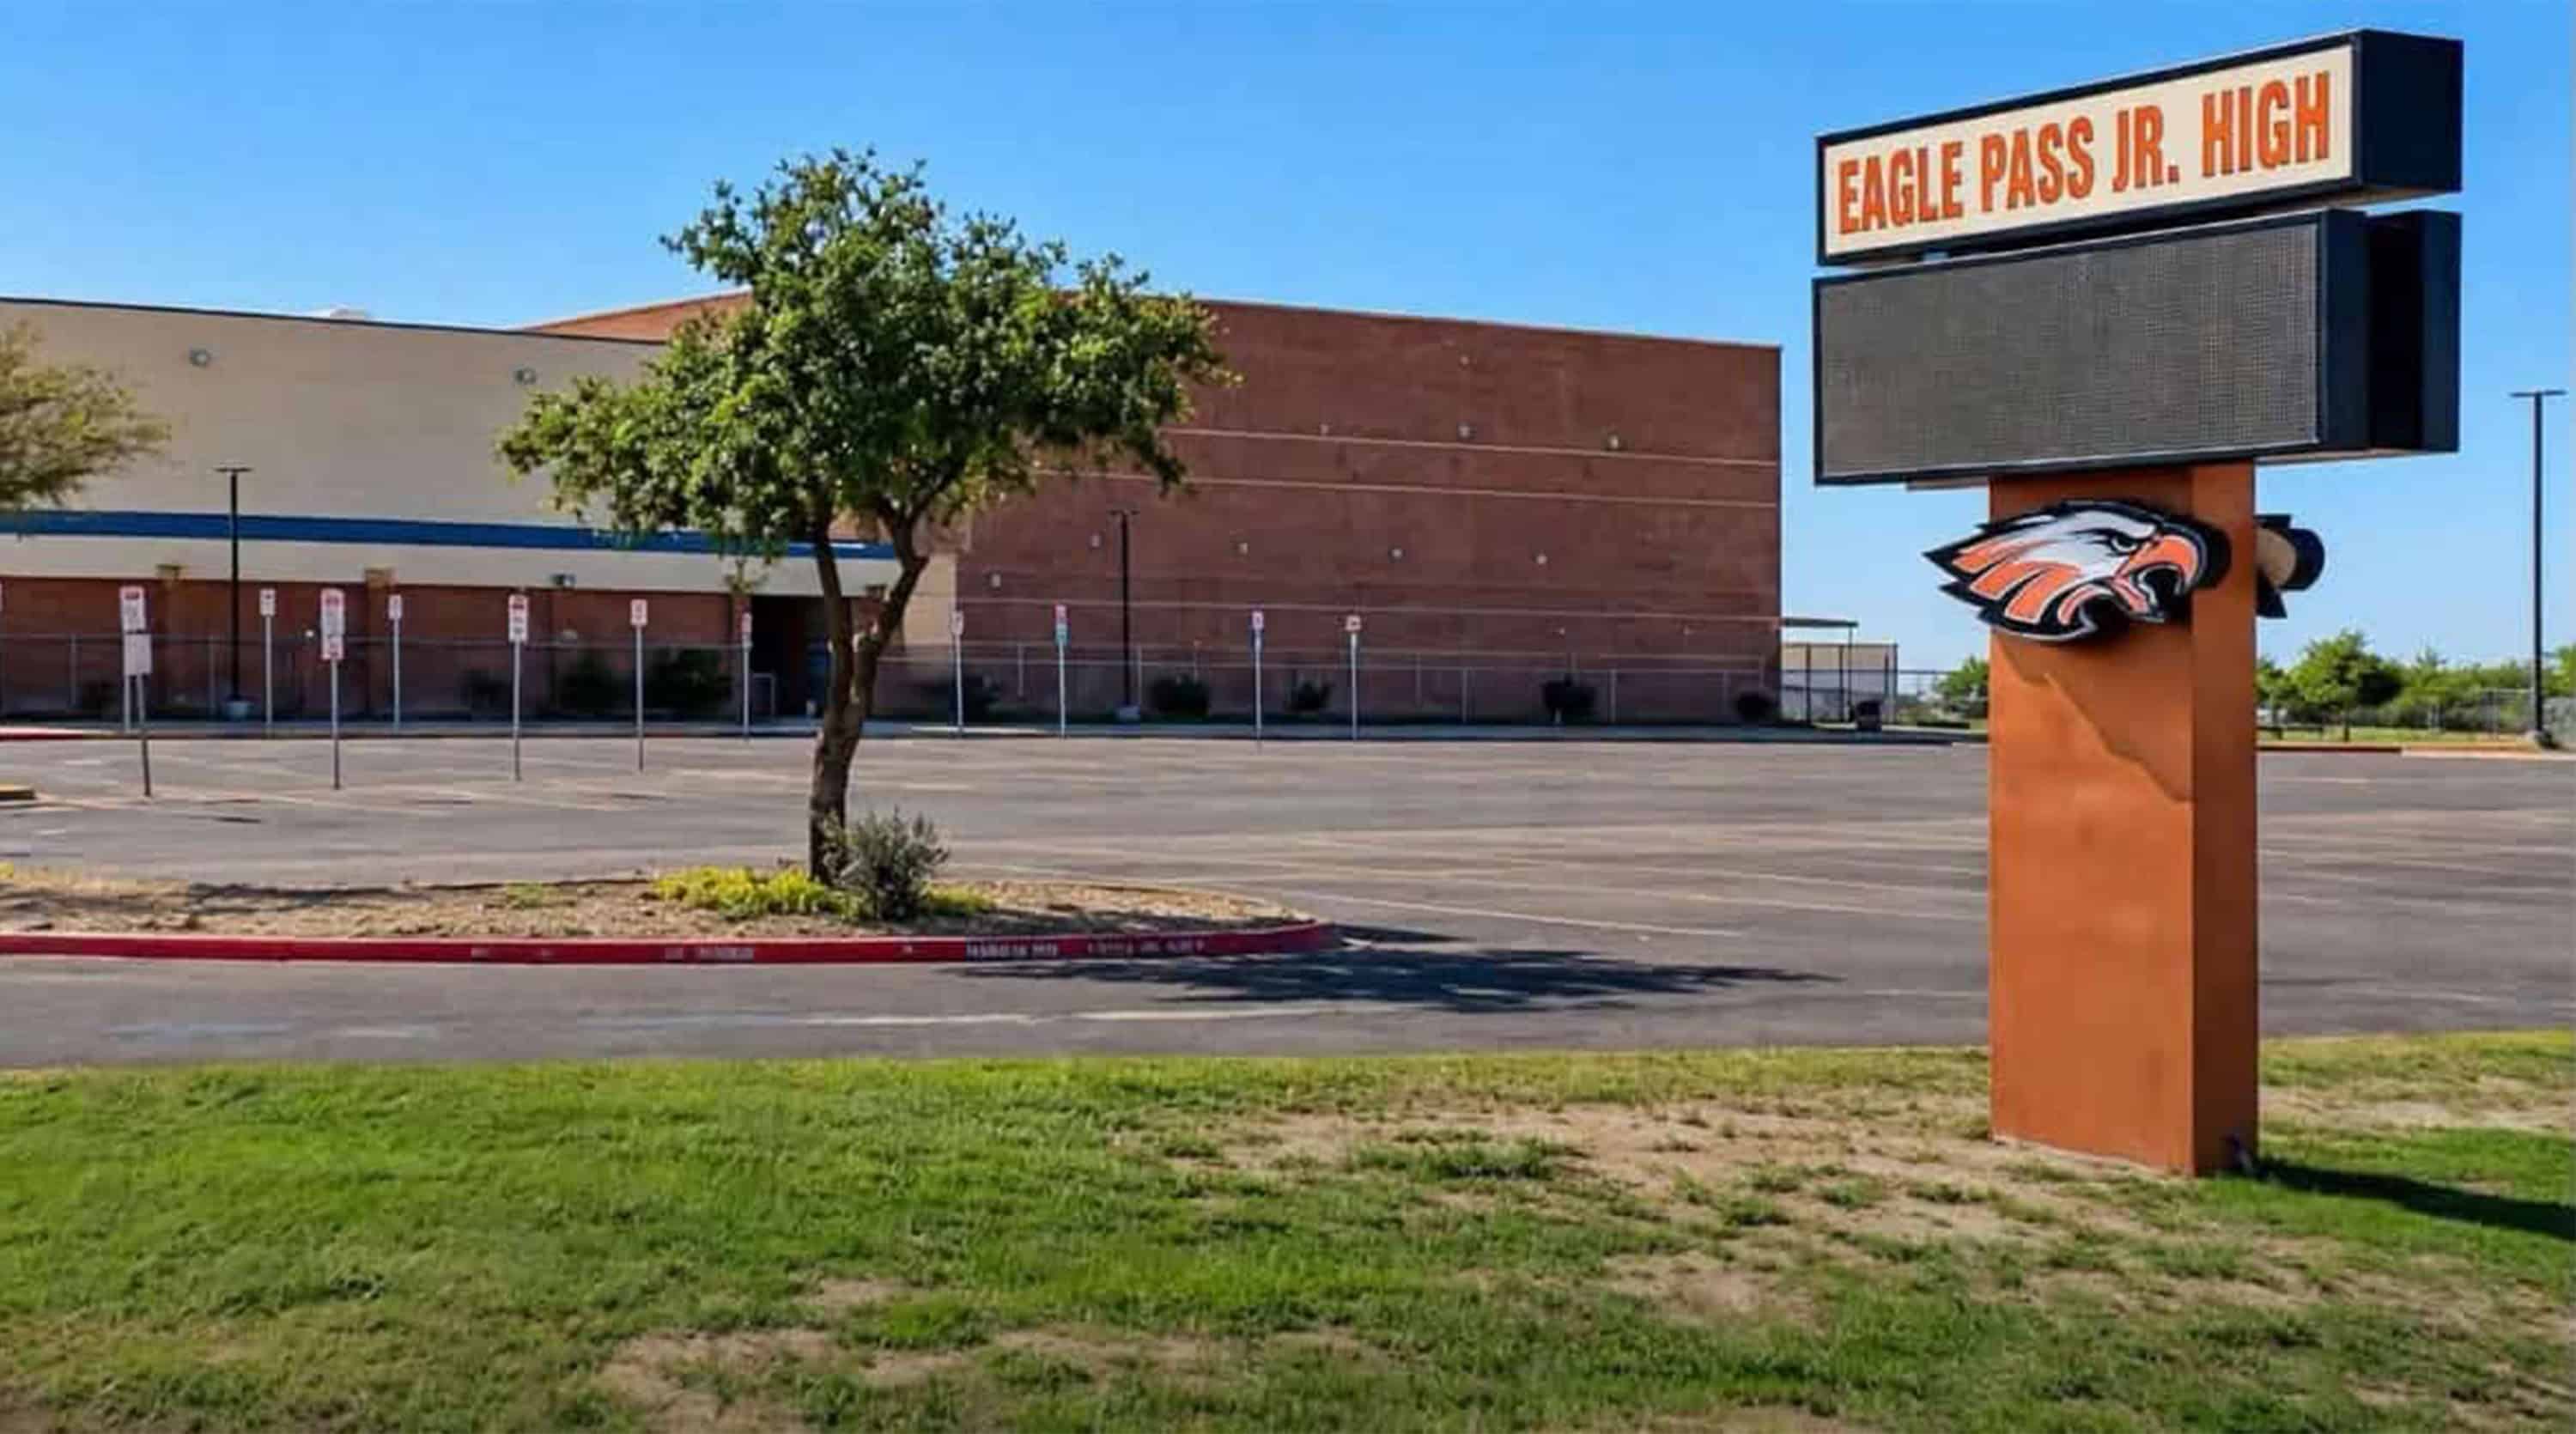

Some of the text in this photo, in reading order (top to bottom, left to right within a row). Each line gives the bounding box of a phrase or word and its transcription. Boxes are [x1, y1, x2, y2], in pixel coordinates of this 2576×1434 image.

[1838, 71, 2330, 234] EAGLE PASS JR. HIGH
